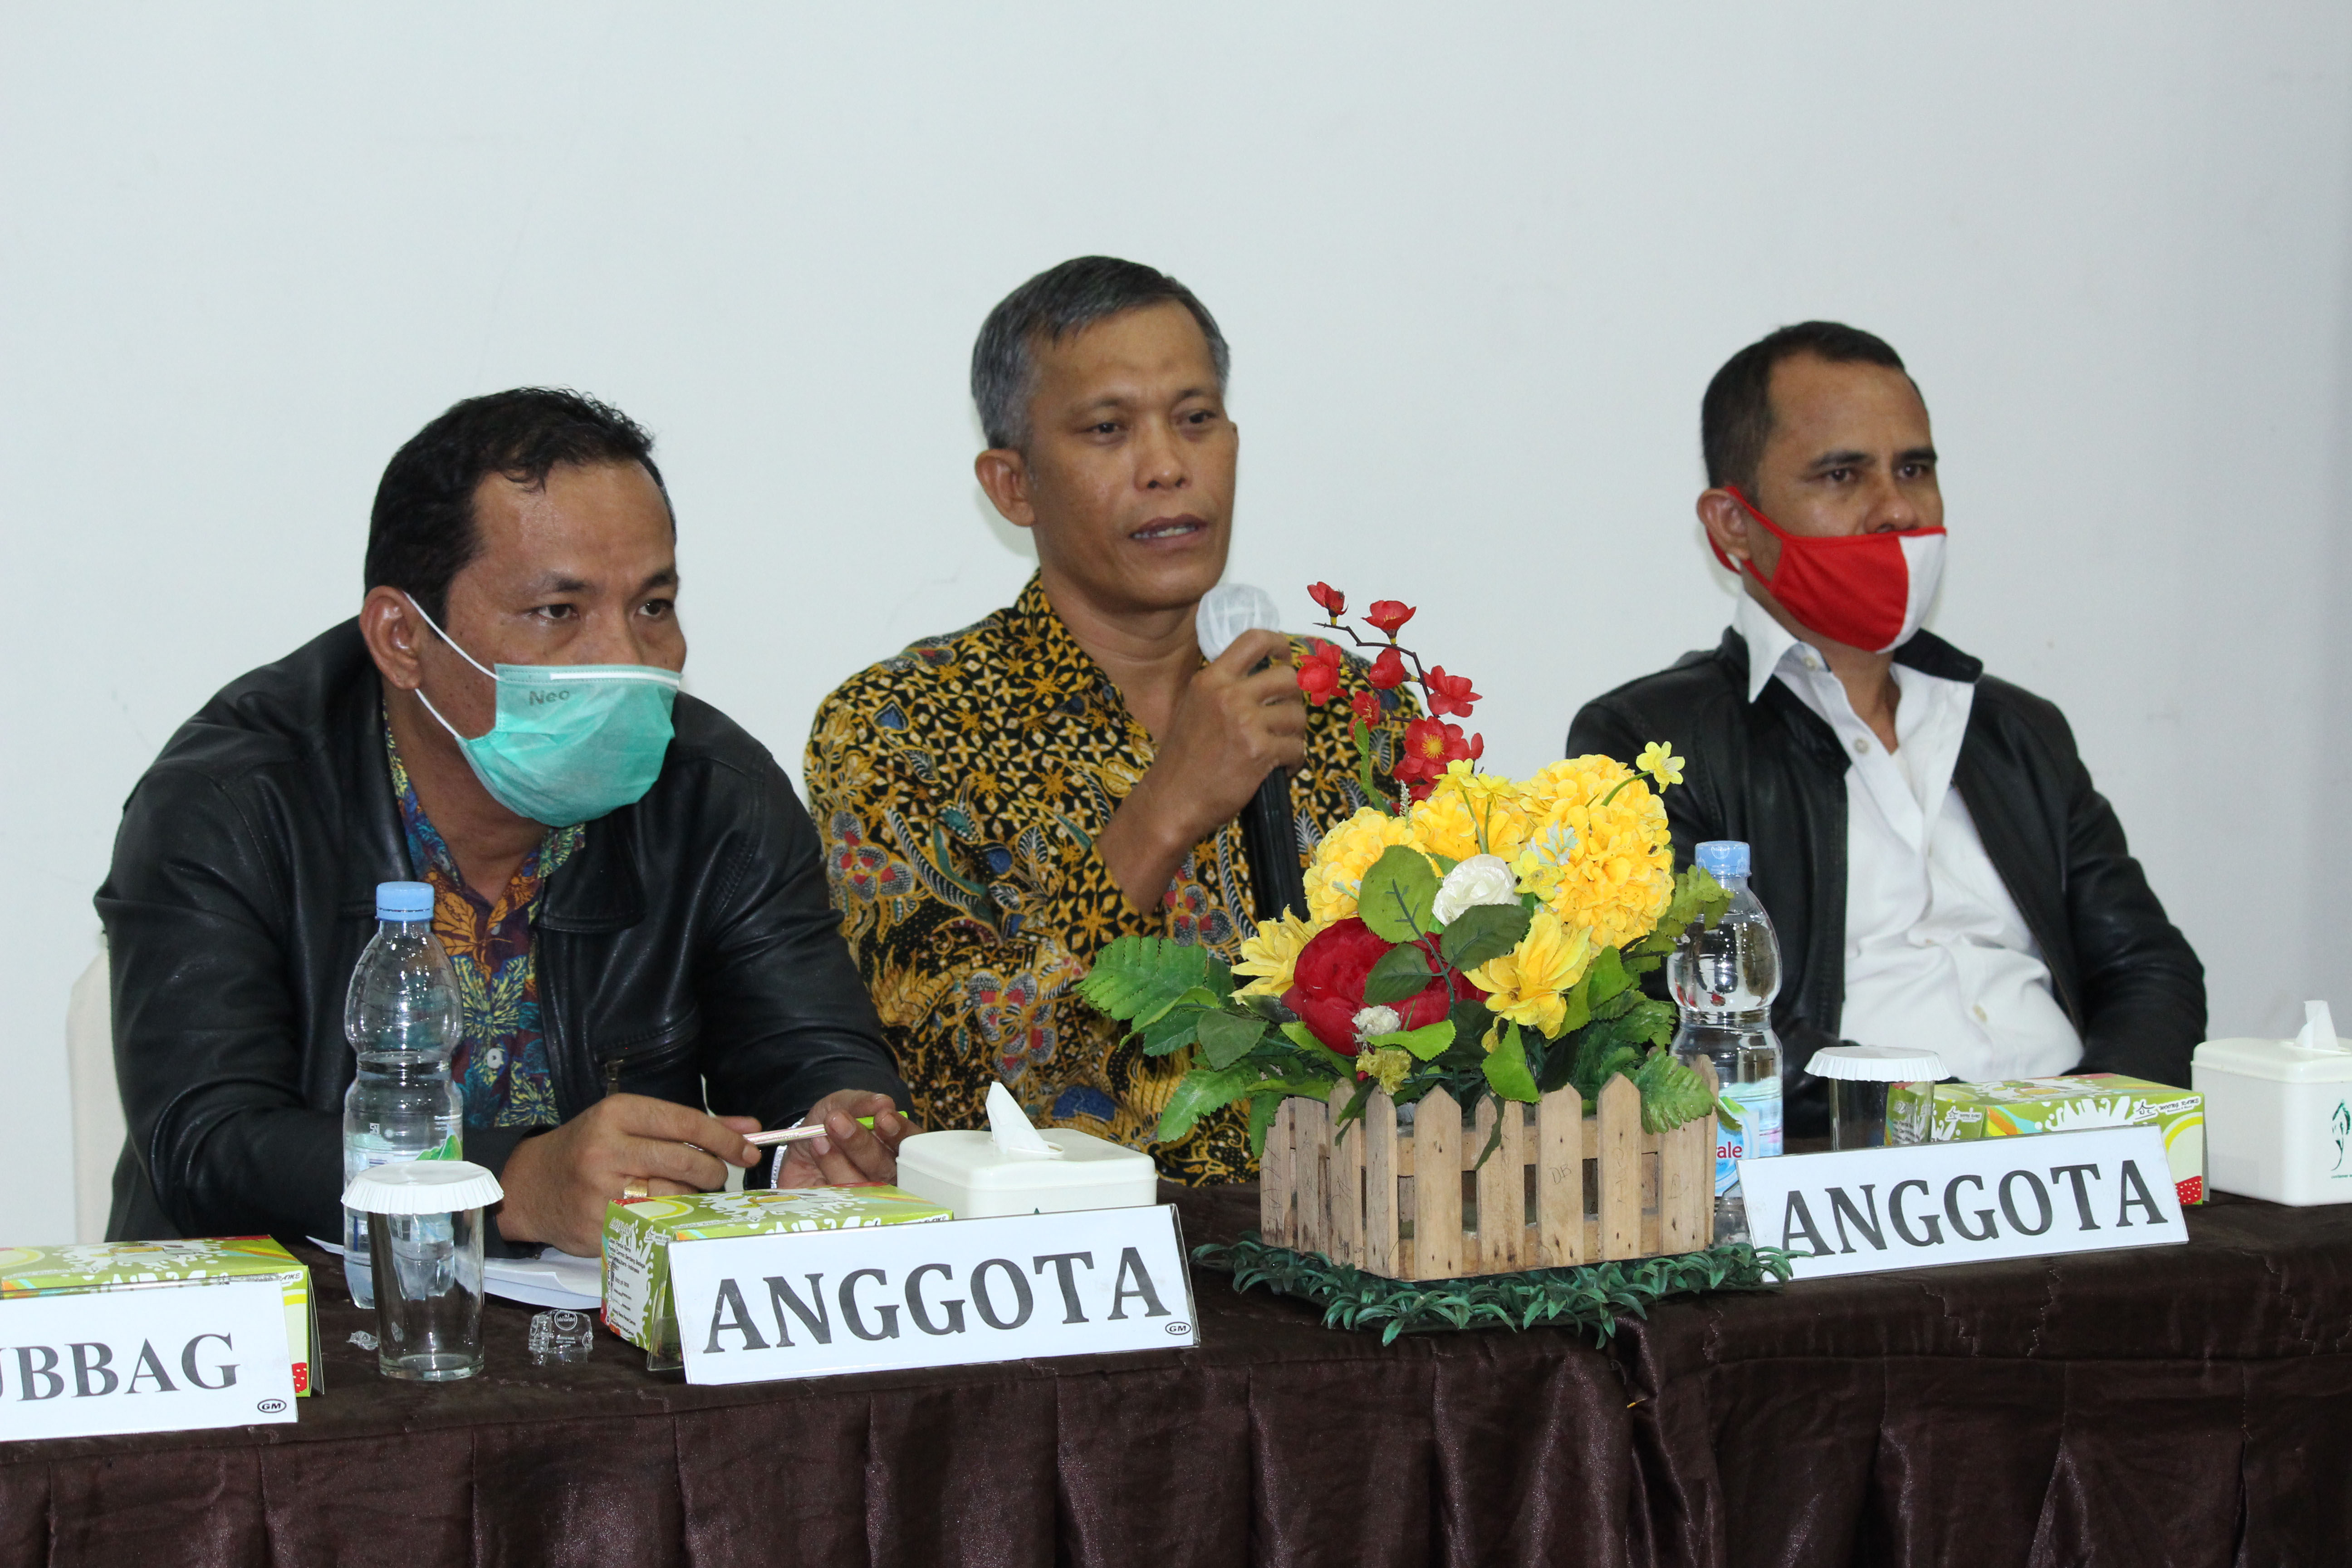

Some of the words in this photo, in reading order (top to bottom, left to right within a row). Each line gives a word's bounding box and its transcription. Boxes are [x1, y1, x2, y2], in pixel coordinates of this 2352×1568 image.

[529, 690, 570, 706] Neo
[1717, 1141, 1743, 1158] ale
[1782, 1160, 2168, 1259] ANGGOTA
[703, 1247, 1171, 1354] ANGGOTA
[0, 1332, 240, 1401] BBAG
